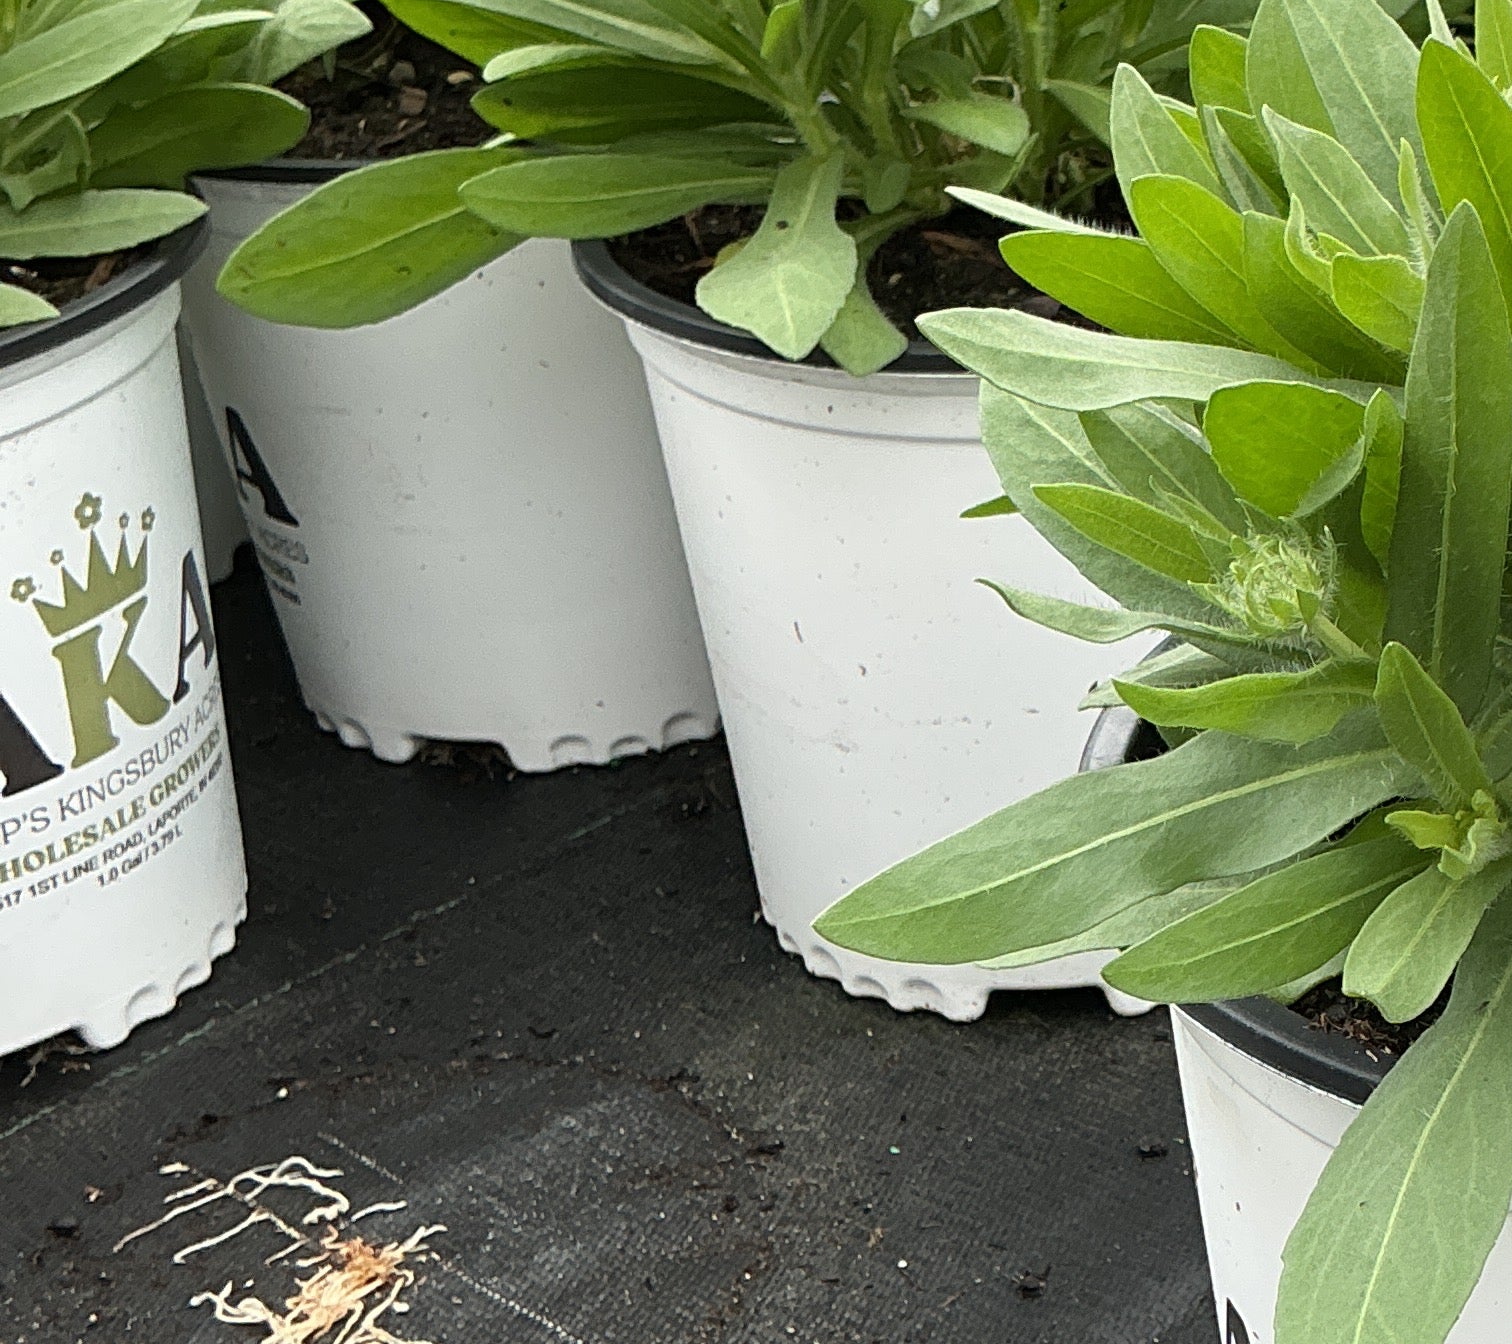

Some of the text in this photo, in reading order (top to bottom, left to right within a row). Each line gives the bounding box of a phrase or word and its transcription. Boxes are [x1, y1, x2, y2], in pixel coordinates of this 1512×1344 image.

[58, 714, 191, 822] KINGSBURY
[28, 872, 60, 898] 1ST
[62, 854, 99, 884] LINE
